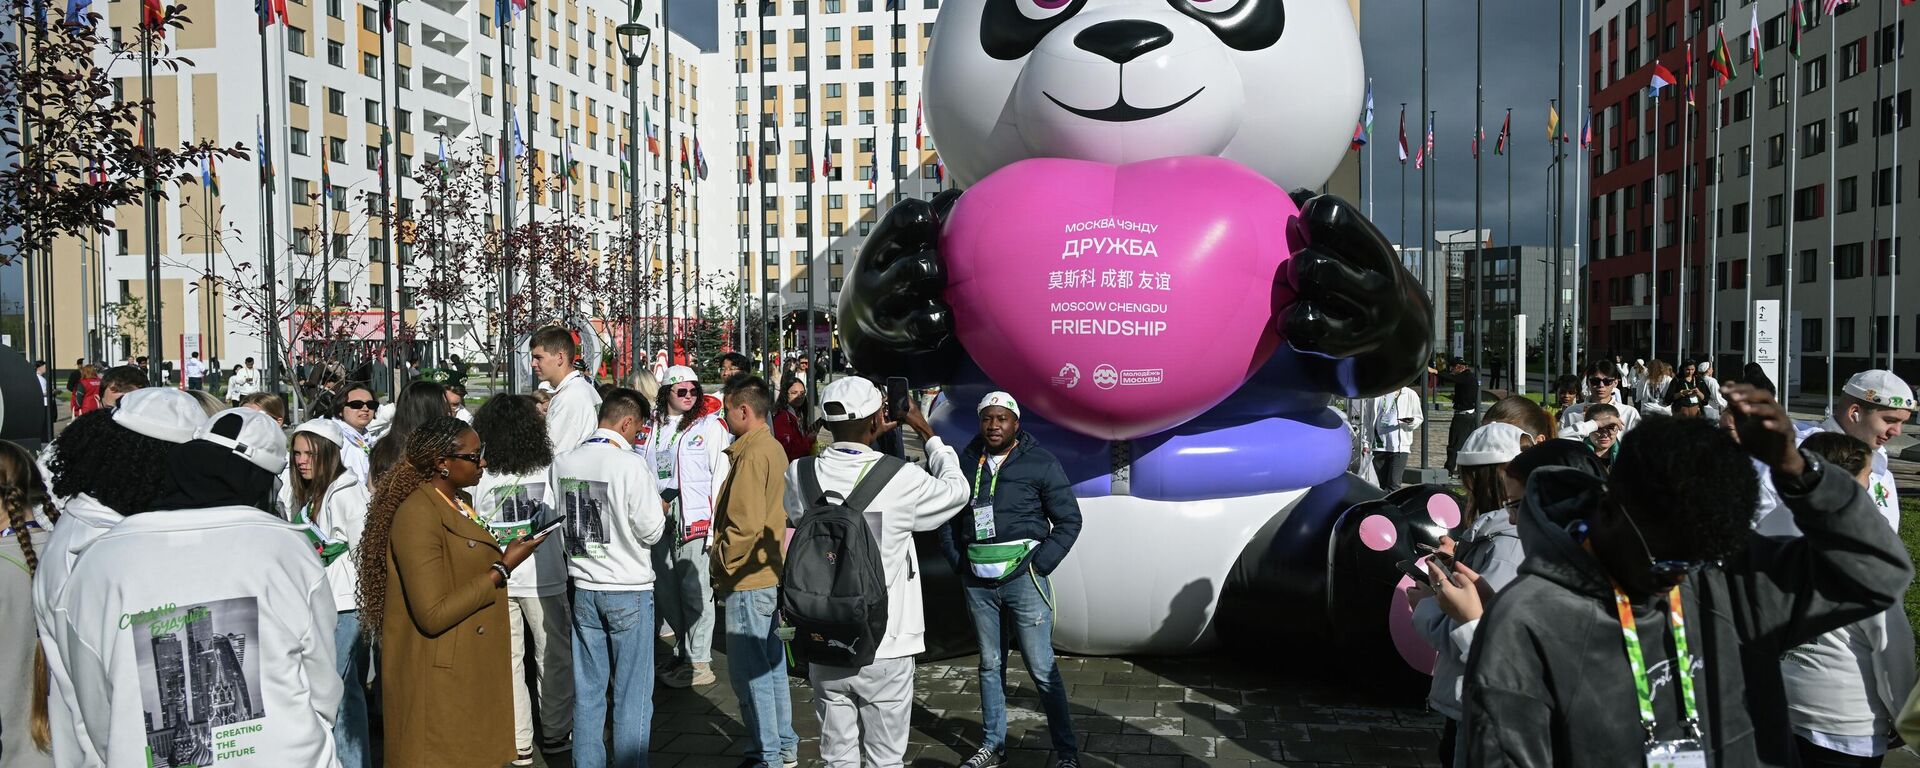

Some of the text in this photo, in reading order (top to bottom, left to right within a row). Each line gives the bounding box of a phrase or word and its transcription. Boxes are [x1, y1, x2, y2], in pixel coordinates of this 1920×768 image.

[1065, 218, 1158, 233] МОСКВА ЧЭНДУ
[1062, 238, 1158, 259] ДРУЖБА
[1048, 268, 1171, 291] 莫斯科 成都 友谊
[1051, 301, 1168, 313] MOSCOW CHENGDU
[1051, 319, 1167, 336] FRIENDSHIP
[1122, 376, 1161, 384] МОСКВЫ
[215, 724, 263, 740] CREATING
[216, 740, 236, 751] THE
[216, 747, 256, 761] FUTURE
